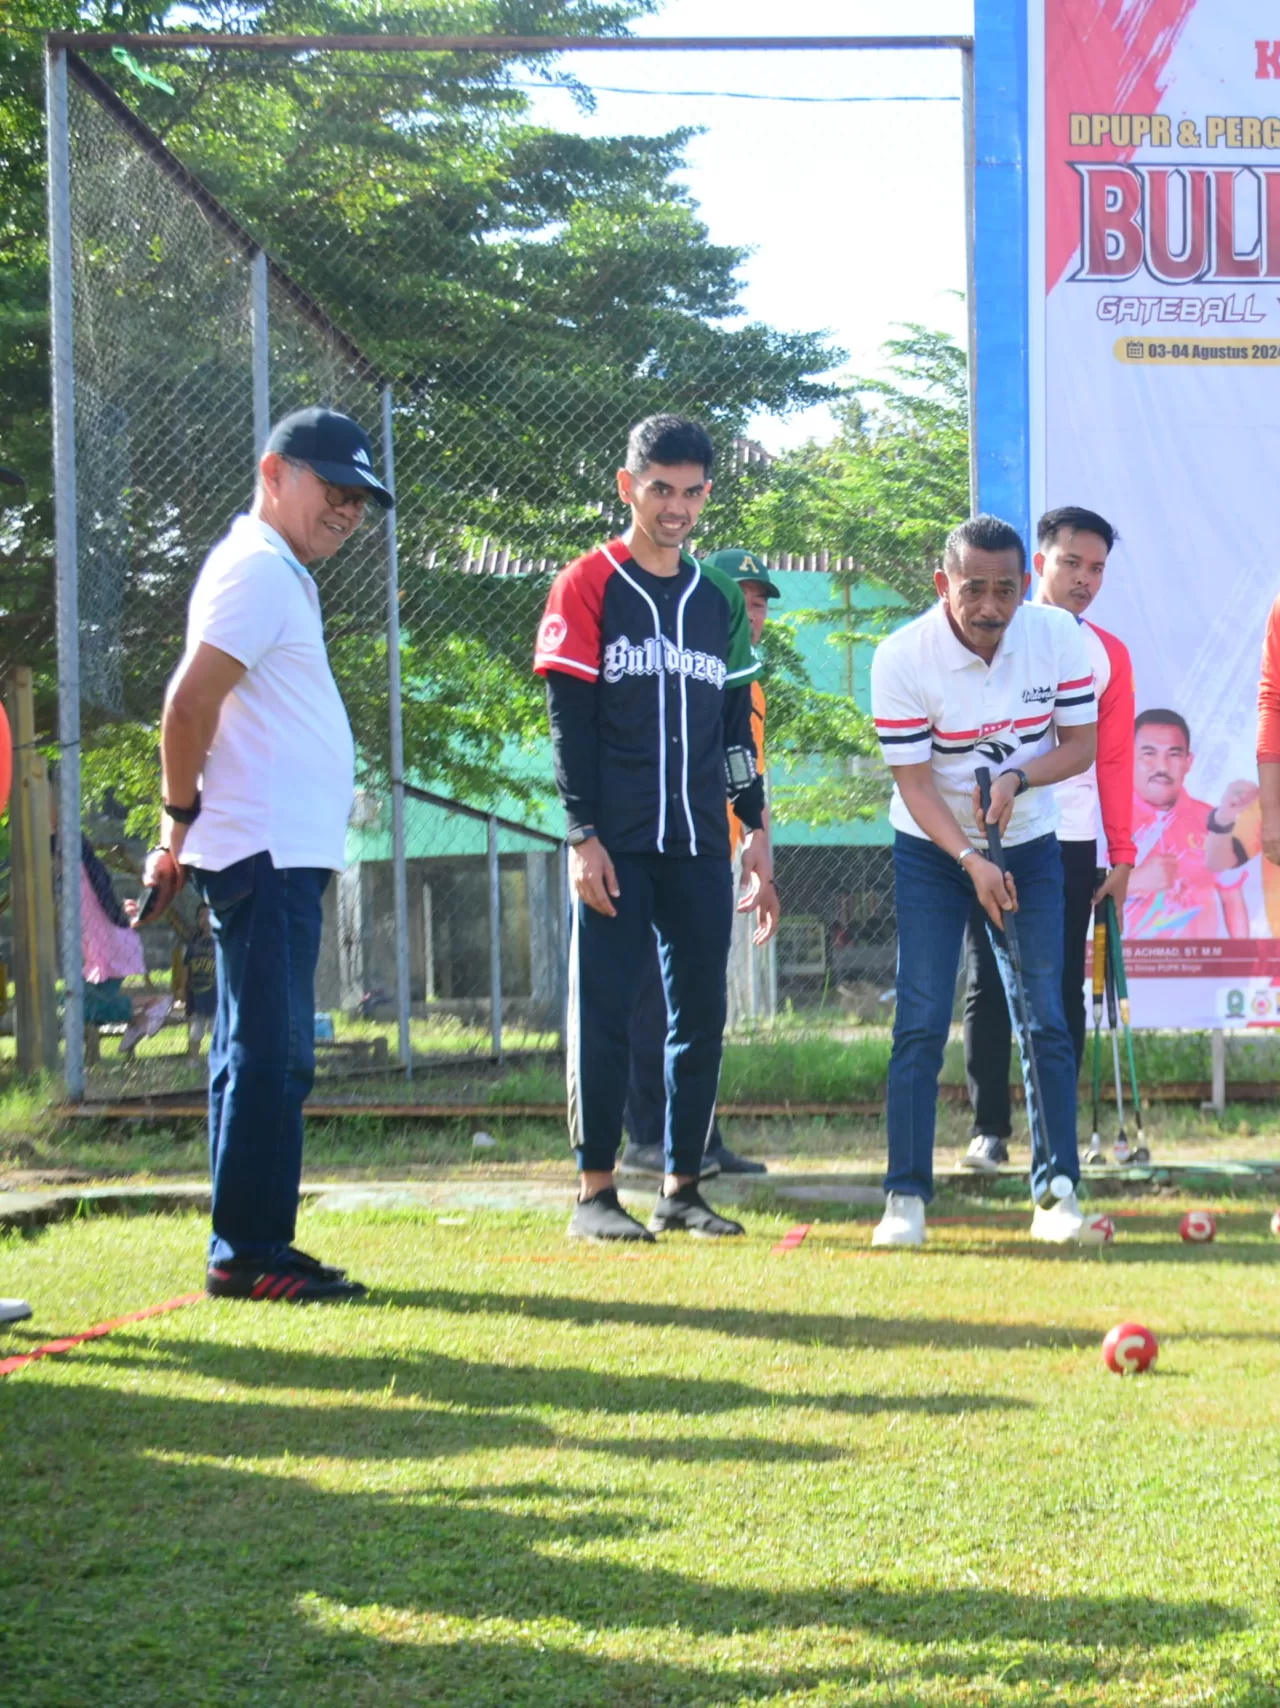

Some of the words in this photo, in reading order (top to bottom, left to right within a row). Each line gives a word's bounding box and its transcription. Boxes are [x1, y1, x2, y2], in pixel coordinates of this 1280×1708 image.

[1069, 113, 1171, 147] DPUPR
[1177, 119, 1201, 148] &
[1096, 293, 1268, 327] GATEBALL
[1148, 343, 1189, 359] 03-04
[1191, 344, 1249, 361] Agustus
[738, 555, 760, 575] A
[604, 632, 728, 691] Bulldozer
[1090, 1213, 1113, 1241] 4
